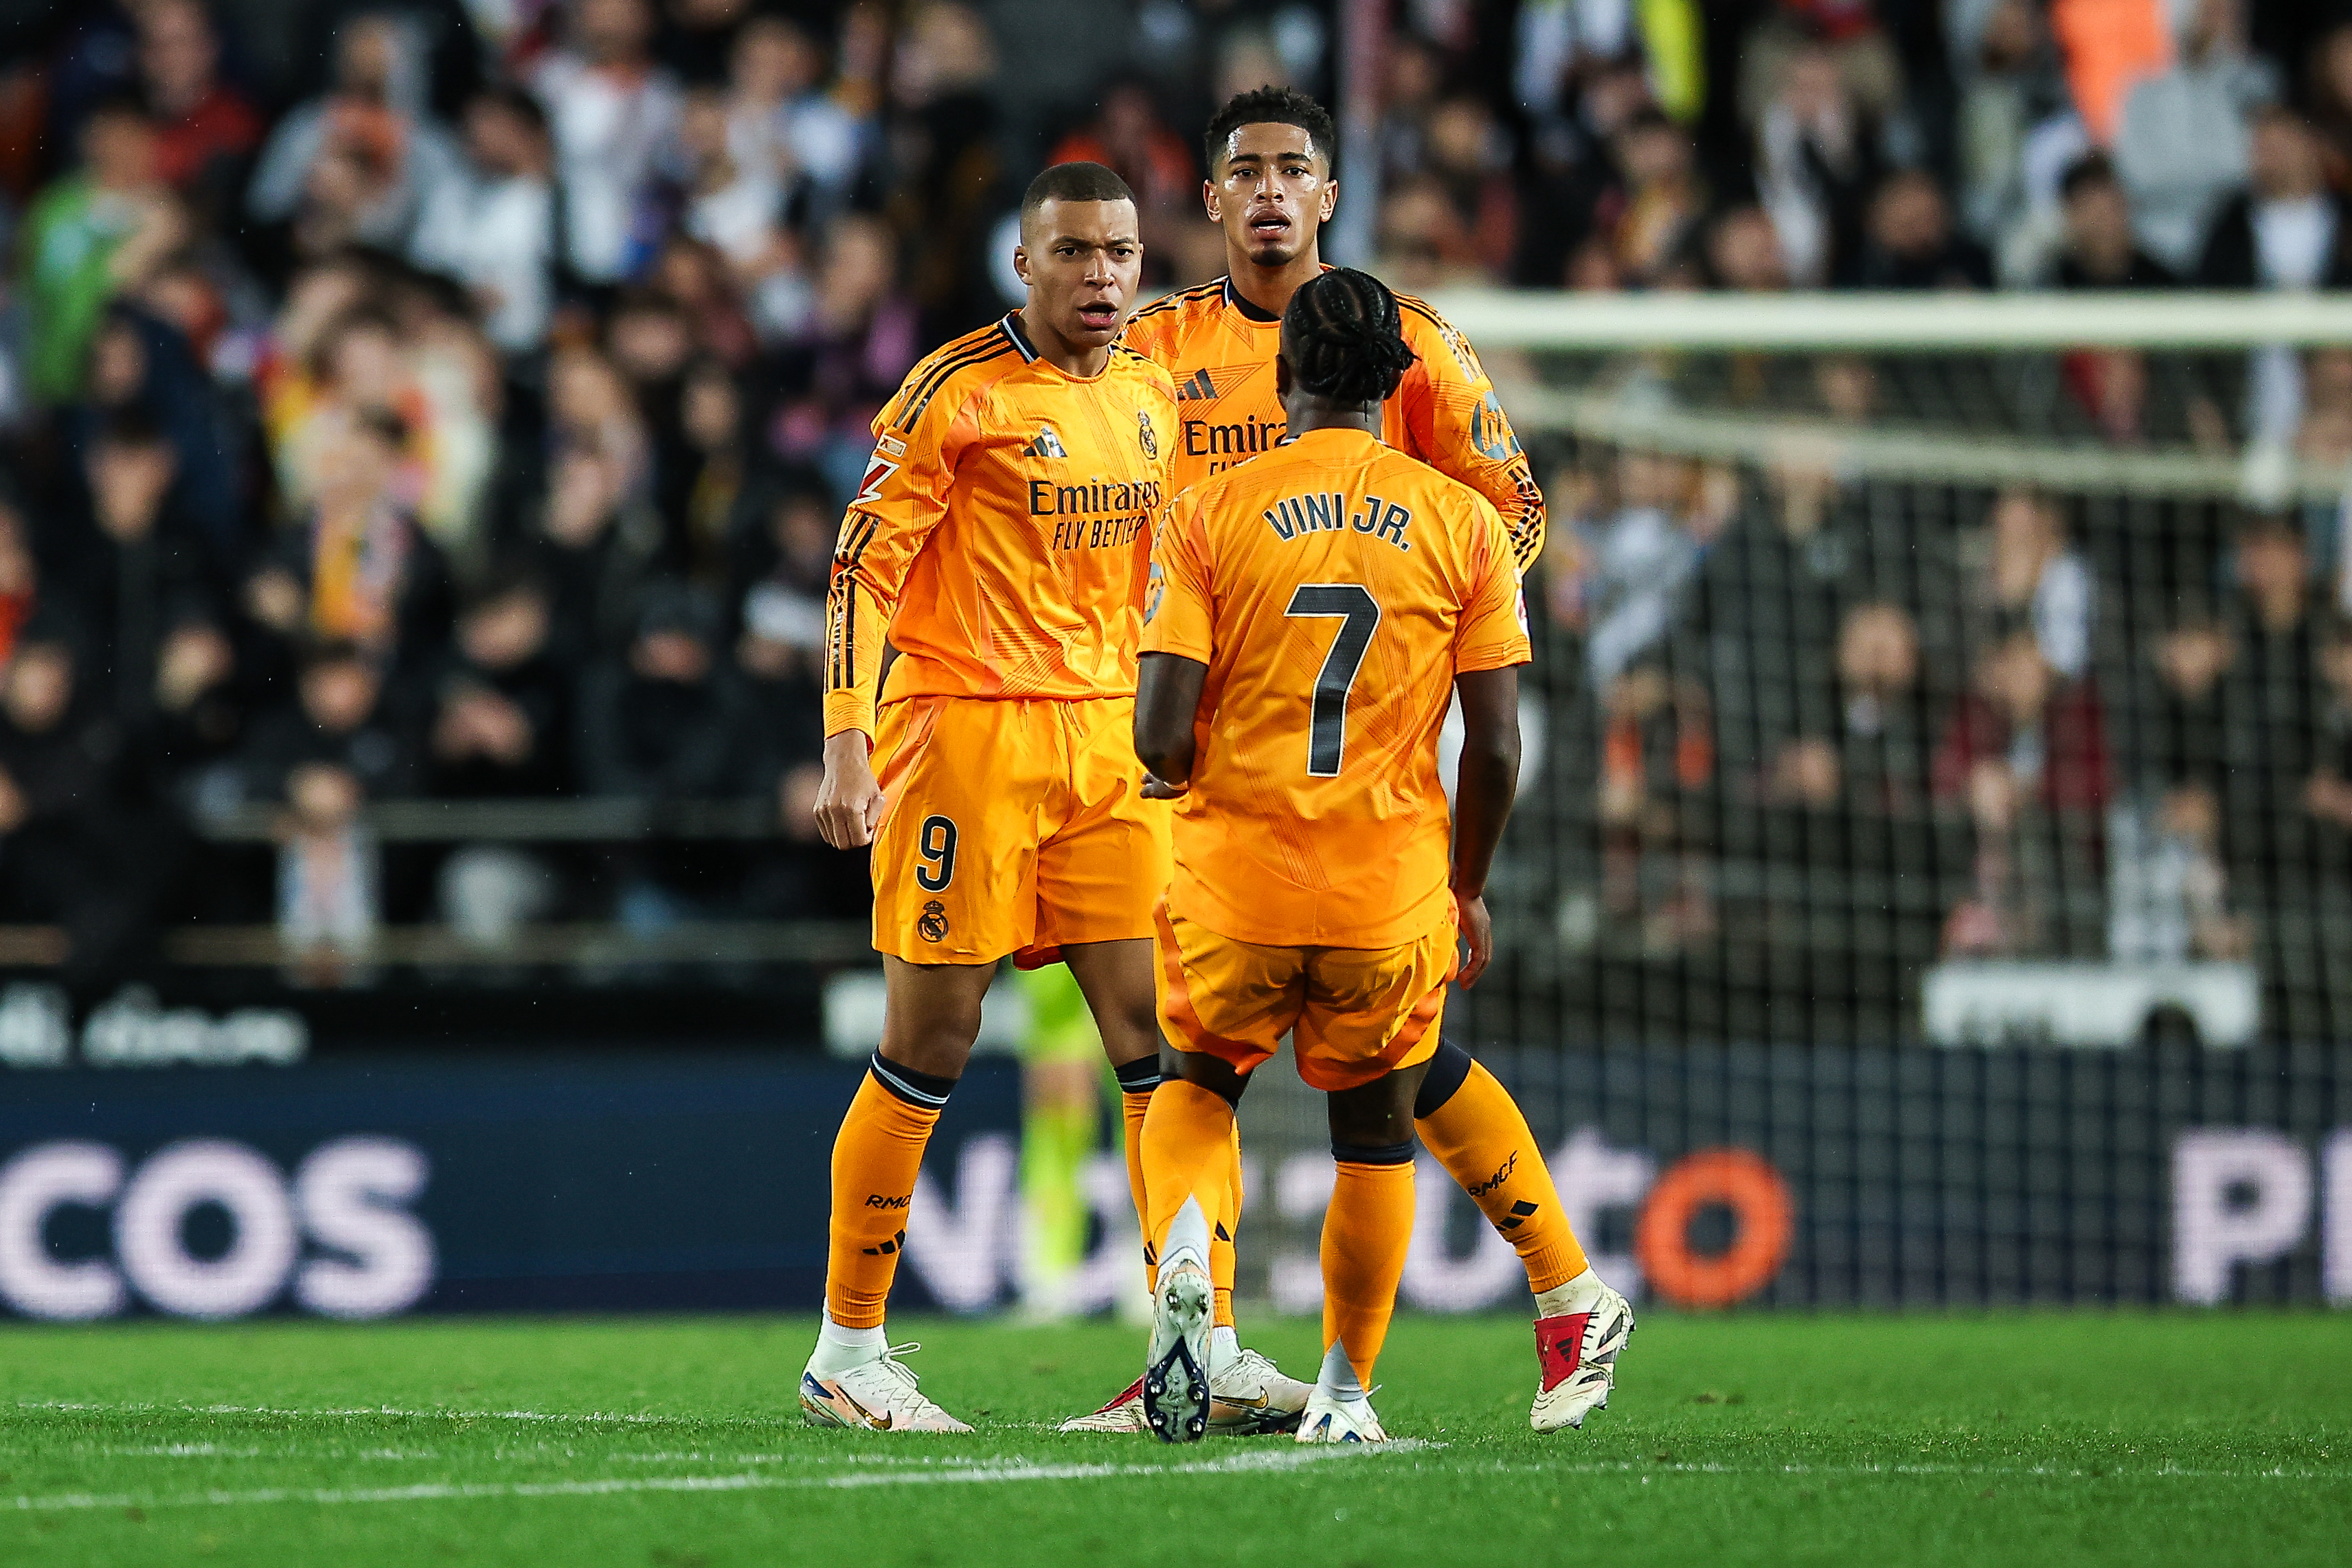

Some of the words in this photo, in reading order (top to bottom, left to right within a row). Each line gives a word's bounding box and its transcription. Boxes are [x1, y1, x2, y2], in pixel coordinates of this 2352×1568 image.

[1030, 476, 1160, 515] Emirates
[1262, 492, 1344, 542] VINI
[1351, 495, 1412, 553] JR.
[1052, 521, 1087, 550] FLY
[1283, 582, 1382, 777] 7
[915, 814, 959, 893] 9
[1469, 1150, 1518, 1197] RMCF
[0, 1135, 438, 1317] COS
